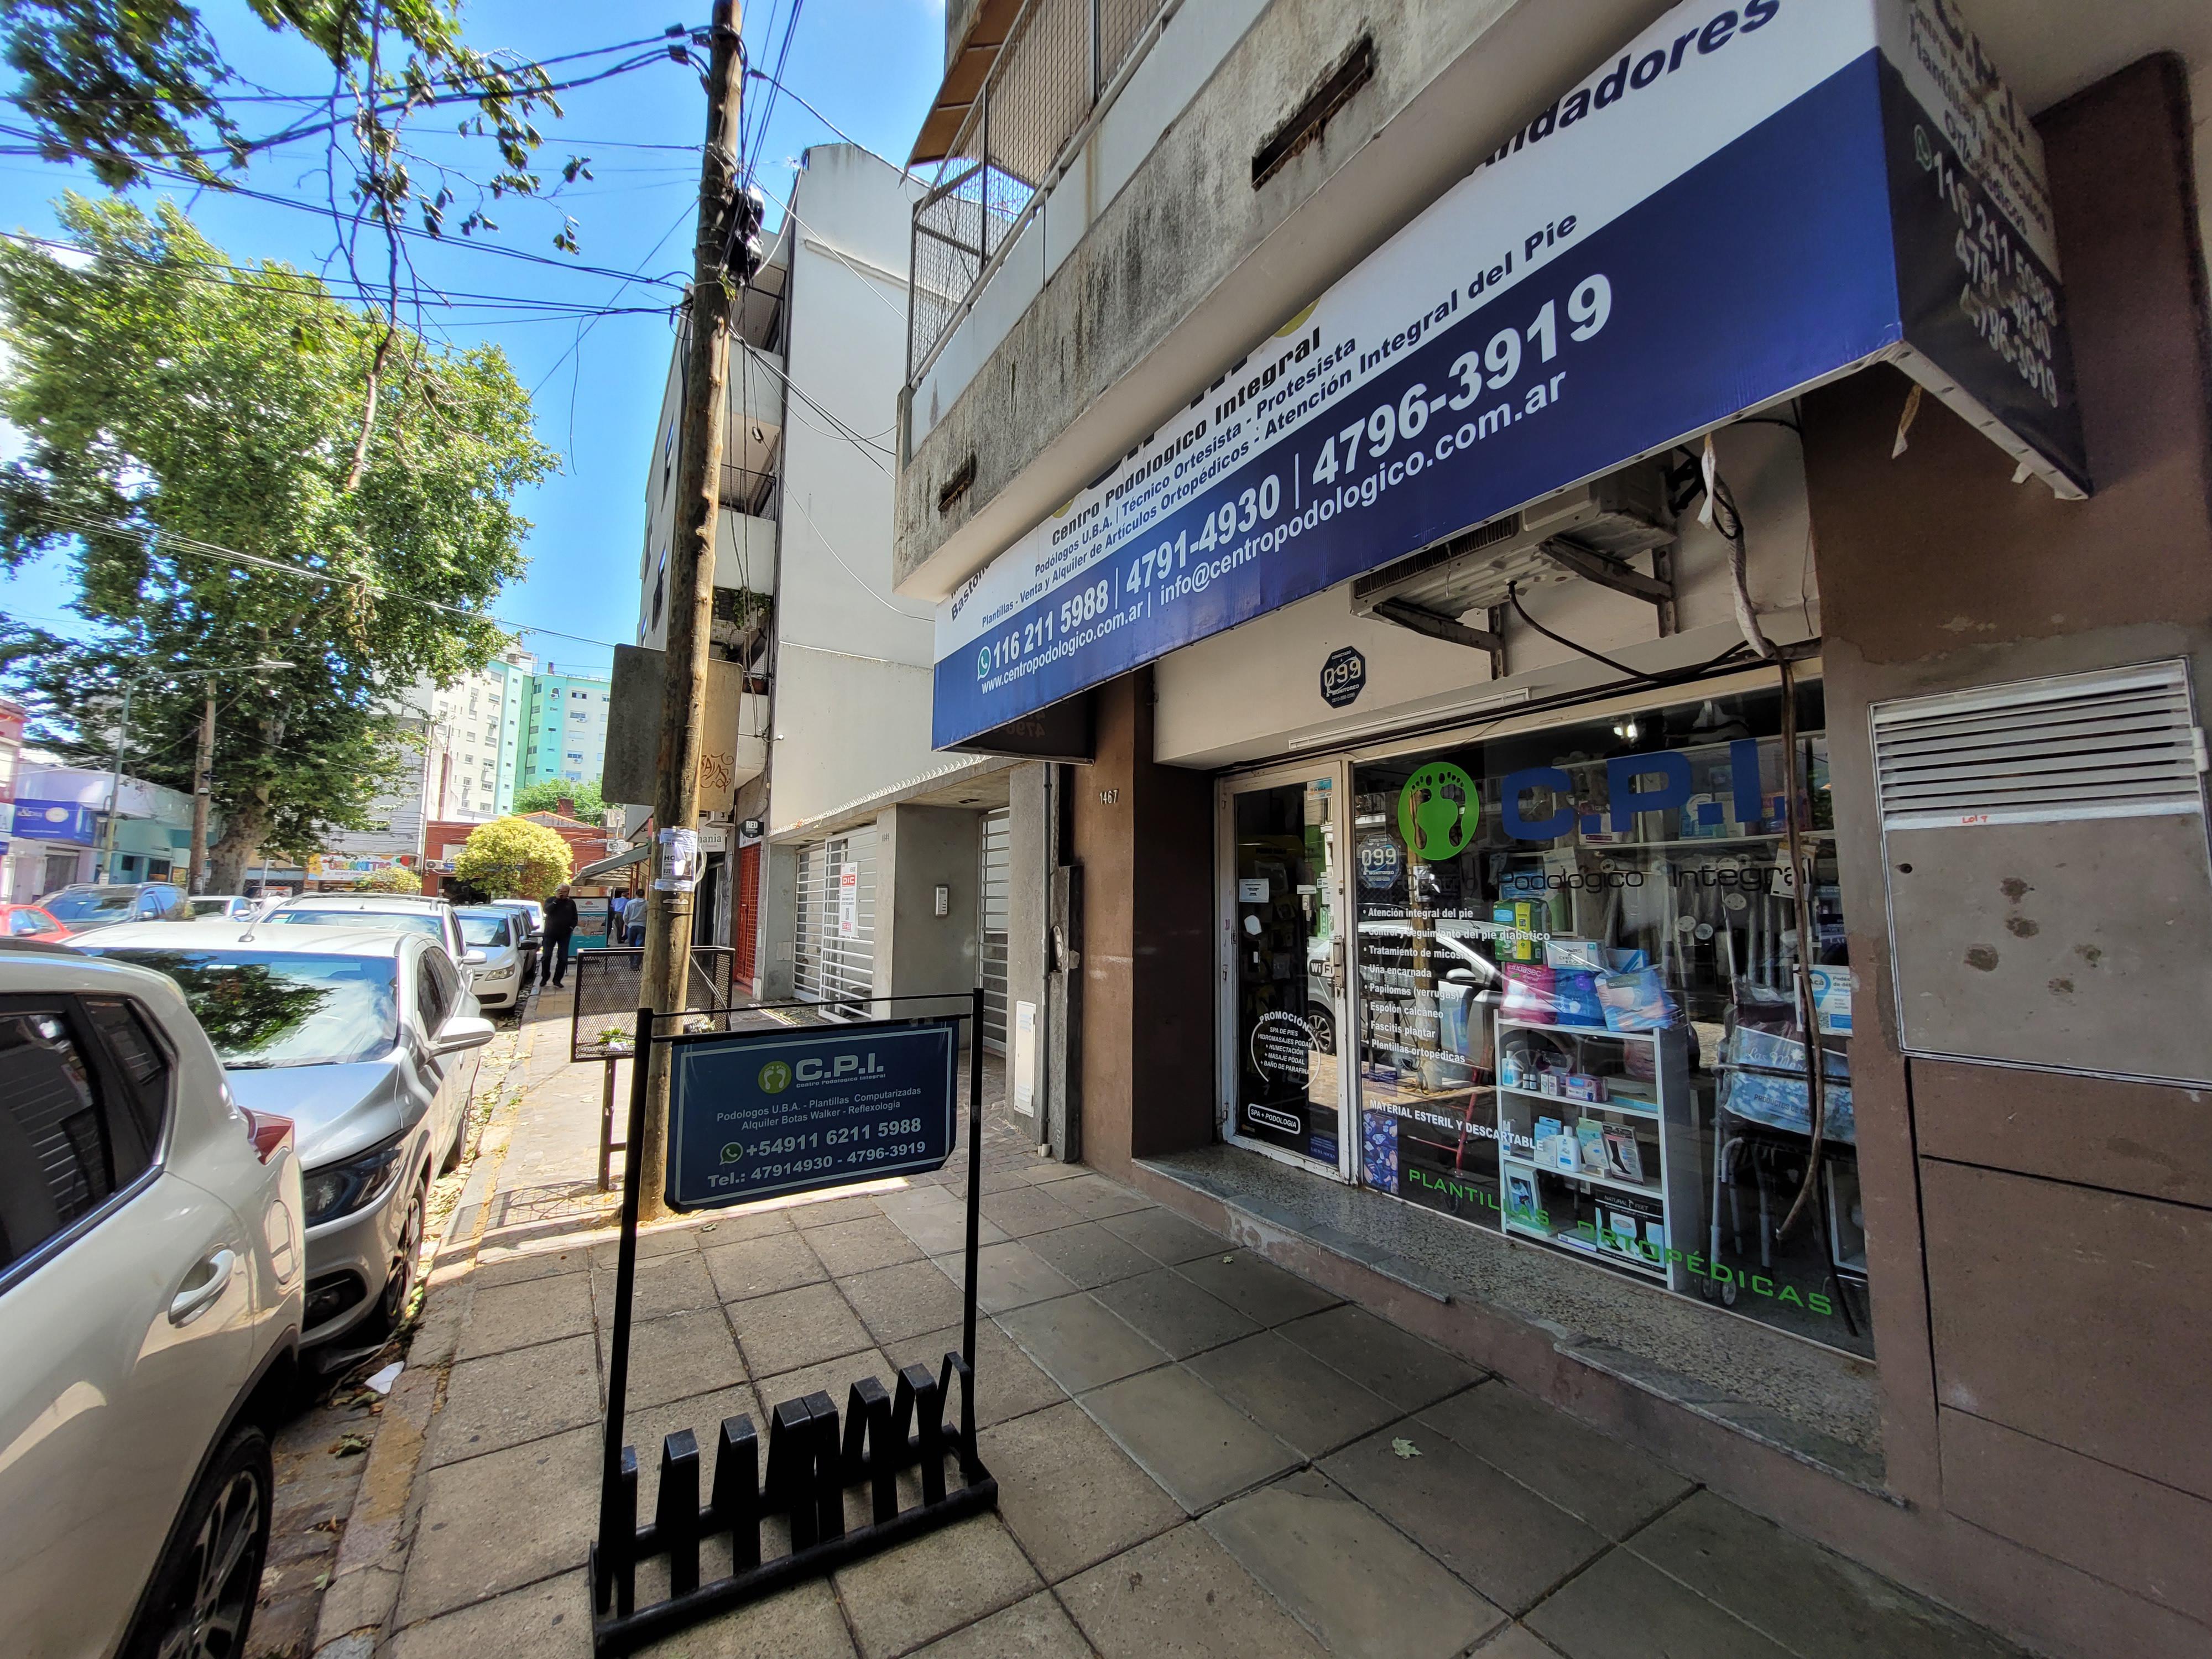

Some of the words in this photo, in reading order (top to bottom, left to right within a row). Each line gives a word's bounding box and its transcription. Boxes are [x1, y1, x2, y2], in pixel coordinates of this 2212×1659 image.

[1934, 151, 1973, 230] 116
[1976, 203, 2010, 276] 211
[981, 600, 1014, 628] Plantillas
[1020, 581, 1043, 604] Venta
[1045, 577, 1050, 592] y
[1052, 554, 1088, 583] Alquiler
[1090, 541, 1102, 559] de
[1105, 505, 1157, 549] Artículos
[1161, 441, 1249, 510] Ortopédicos
[1264, 369, 1352, 441] Atención
[1360, 290, 1457, 373] Integral
[1468, 251, 1512, 300] del
[1524, 215, 1577, 264] Pie
[1052, 502, 1100, 546] Centro
[1105, 420, 1207, 509] Podologico
[1215, 326, 1320, 426] Integral
[1035, 540, 1079, 577] Podólogos
[1082, 517, 1113, 545] U.B.A.
[1122, 481, 1170, 517] Técnico
[1173, 422, 1241, 479] Ortesista
[1257, 338, 1355, 420] Protesista
[993, 632, 1020, 669] 116
[1024, 611, 1053, 654] 211
[1060, 579, 1108, 634] 5988
[1126, 474, 1280, 594] 4791-4930
[1312, 274, 1612, 487] 4796-3919
[982, 600, 1144, 695] www.centropodologico.com.ar
[1160, 370, 1567, 606] info@centropodologico.com.ar
[1324, 658, 1361, 687] 099
[1099, 789, 1119, 805] 1467
[1361, 848, 1396, 867] 099
[1498, 868, 1644, 894] Podologico
[1673, 858, 1811, 891] Integral
[1368, 907, 1404, 919] Atención
[1406, 908, 1440, 920] integral
[1442, 909, 1456, 919] del
[1458, 909, 1474, 920] pie
[1464, 929, 1479, 939] del
[1481, 929, 1497, 941] pie
[1369, 946, 1418, 957] Tratamiento
[1420, 947, 1432, 957] de
[1369, 964, 1384, 974] Uña
[1385, 968, 1432, 978] encarnada
[1370, 983, 1411, 995] Papilomas
[1413, 987, 1460, 1000] (verrugas)
[1370, 1001, 1402, 1015] Espolón
[1404, 1005, 1444, 1019] calcáneo
[1259, 1010, 1310, 1032] PROMOCIÓN
[1370, 1021, 1403, 1034] Fascitis
[1404, 1025, 1436, 1039] plantar
[1258, 1033, 1295, 1045] HIDROMASAJES
[1295, 1039, 1312, 1048] PODAL
[1269, 1044, 1304, 1056] HUMECTACIÓN
[1371, 1039, 1410, 1054] Plantillas
[1412, 1047, 1465, 1063] ortopédicas
[795, 1052, 884, 1082] C.P.I.
[1264, 1060, 1277, 1068] BAÑO
[1285, 1065, 1310, 1075] PARAFINA
[1267, 1052, 1288, 1062] MASAJE
[1288, 1056, 1305, 1065] PODAL
[821, 1077, 858, 1085] Podologico
[717, 1108, 769, 1122] Podologos
[772, 1102, 801, 1114] U.B.A.
[809, 1096, 849, 1109] Plantillas
[854, 1087, 921, 1103] Computarizadas
[1754, 1093, 1789, 1110] PRODUCTOS
[741, 1118, 779, 1130] Alquiler
[781, 1114, 808, 1124] Botas
[810, 1108, 841, 1120] Walker
[848, 1099, 900, 1114] Reflexología
[1250, 1109, 1260, 1117] SPA
[1265, 1113, 1297, 1129] PODOLOGIA
[1369, 1099, 1412, 1118] MATERIAL
[1414, 1110, 1454, 1129] ESTERIL
[1455, 1120, 1463, 1131] Y
[1465, 1122, 1544, 1151] DESCARTABLE
[747, 1132, 818, 1156] +54911
[826, 1124, 870, 1145] 6211
[878, 1118, 921, 1138] 5988
[707, 1172, 745, 1188] Tel.:
[751, 1155, 832, 1180] 47914930
[847, 1141, 926, 1164] 4796-3919
[1604, 1195, 1627, 1206] NATURAL
[1408, 1168, 1550, 1226] PLANTILLAS
[1578, 1220, 1832, 1316] ORTOPÉDICAS
